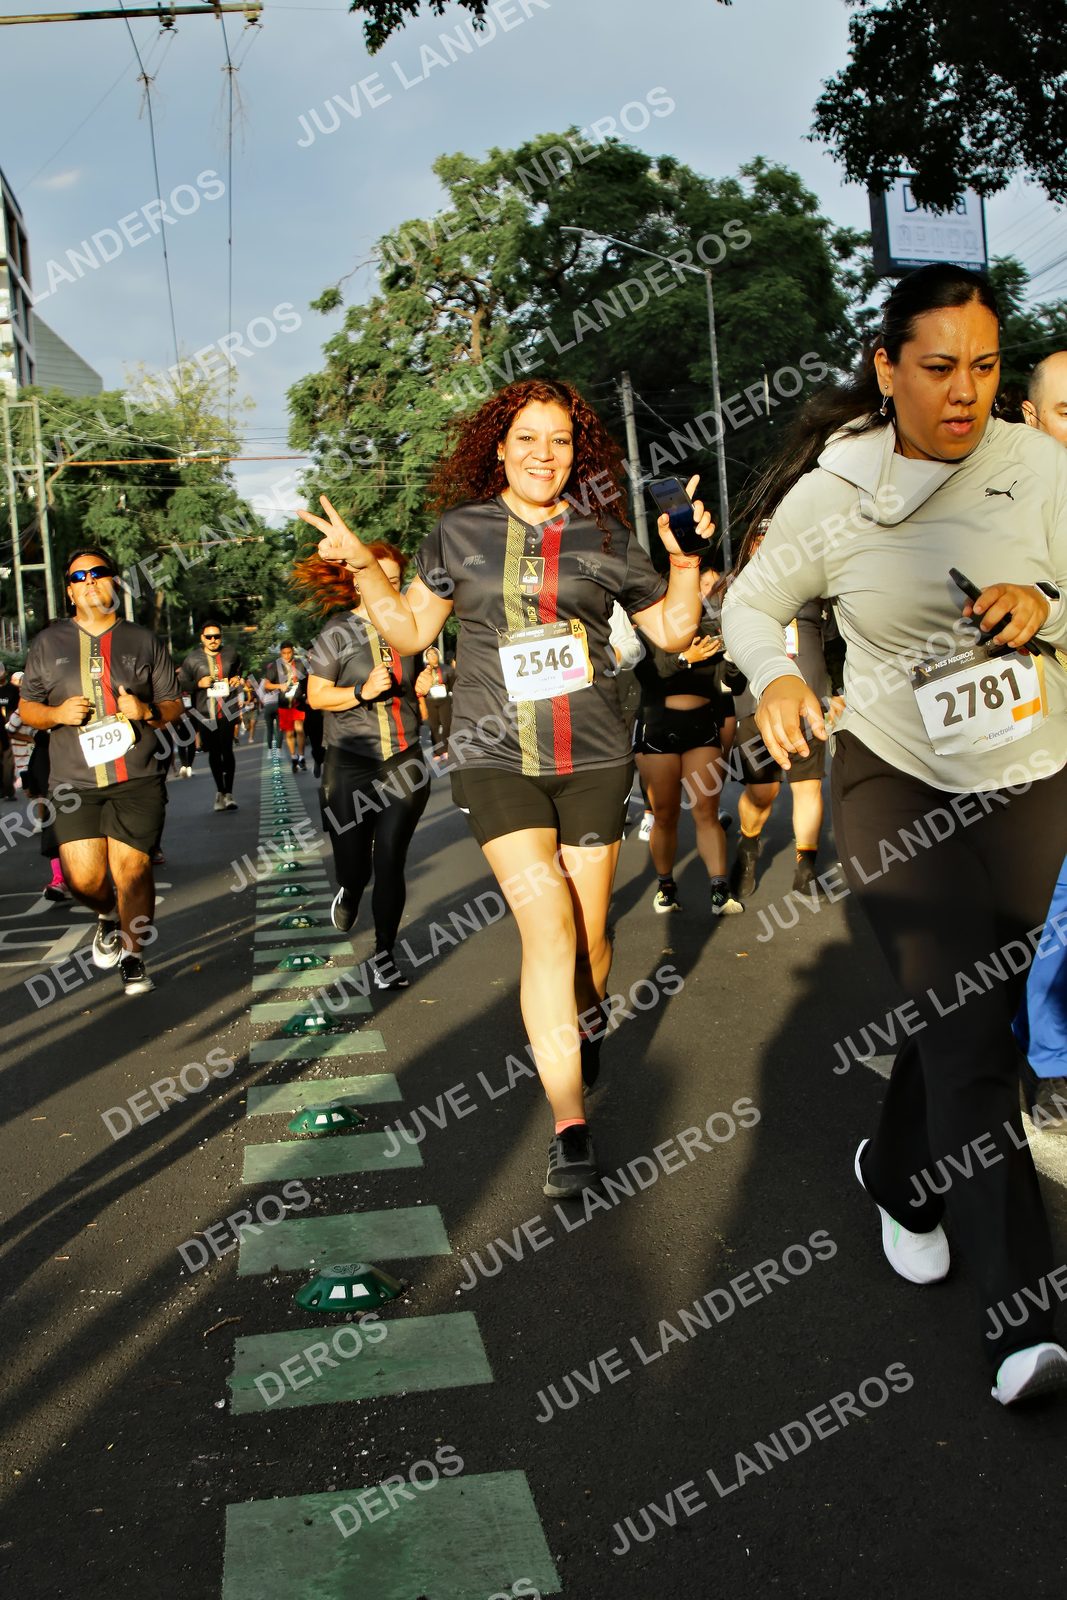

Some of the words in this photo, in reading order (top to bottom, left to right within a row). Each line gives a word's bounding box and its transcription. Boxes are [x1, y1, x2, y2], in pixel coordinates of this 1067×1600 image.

[513, 645, 574, 678] 2546
[935, 667, 1021, 727] 2781
[87, 728, 122, 750] 7299
